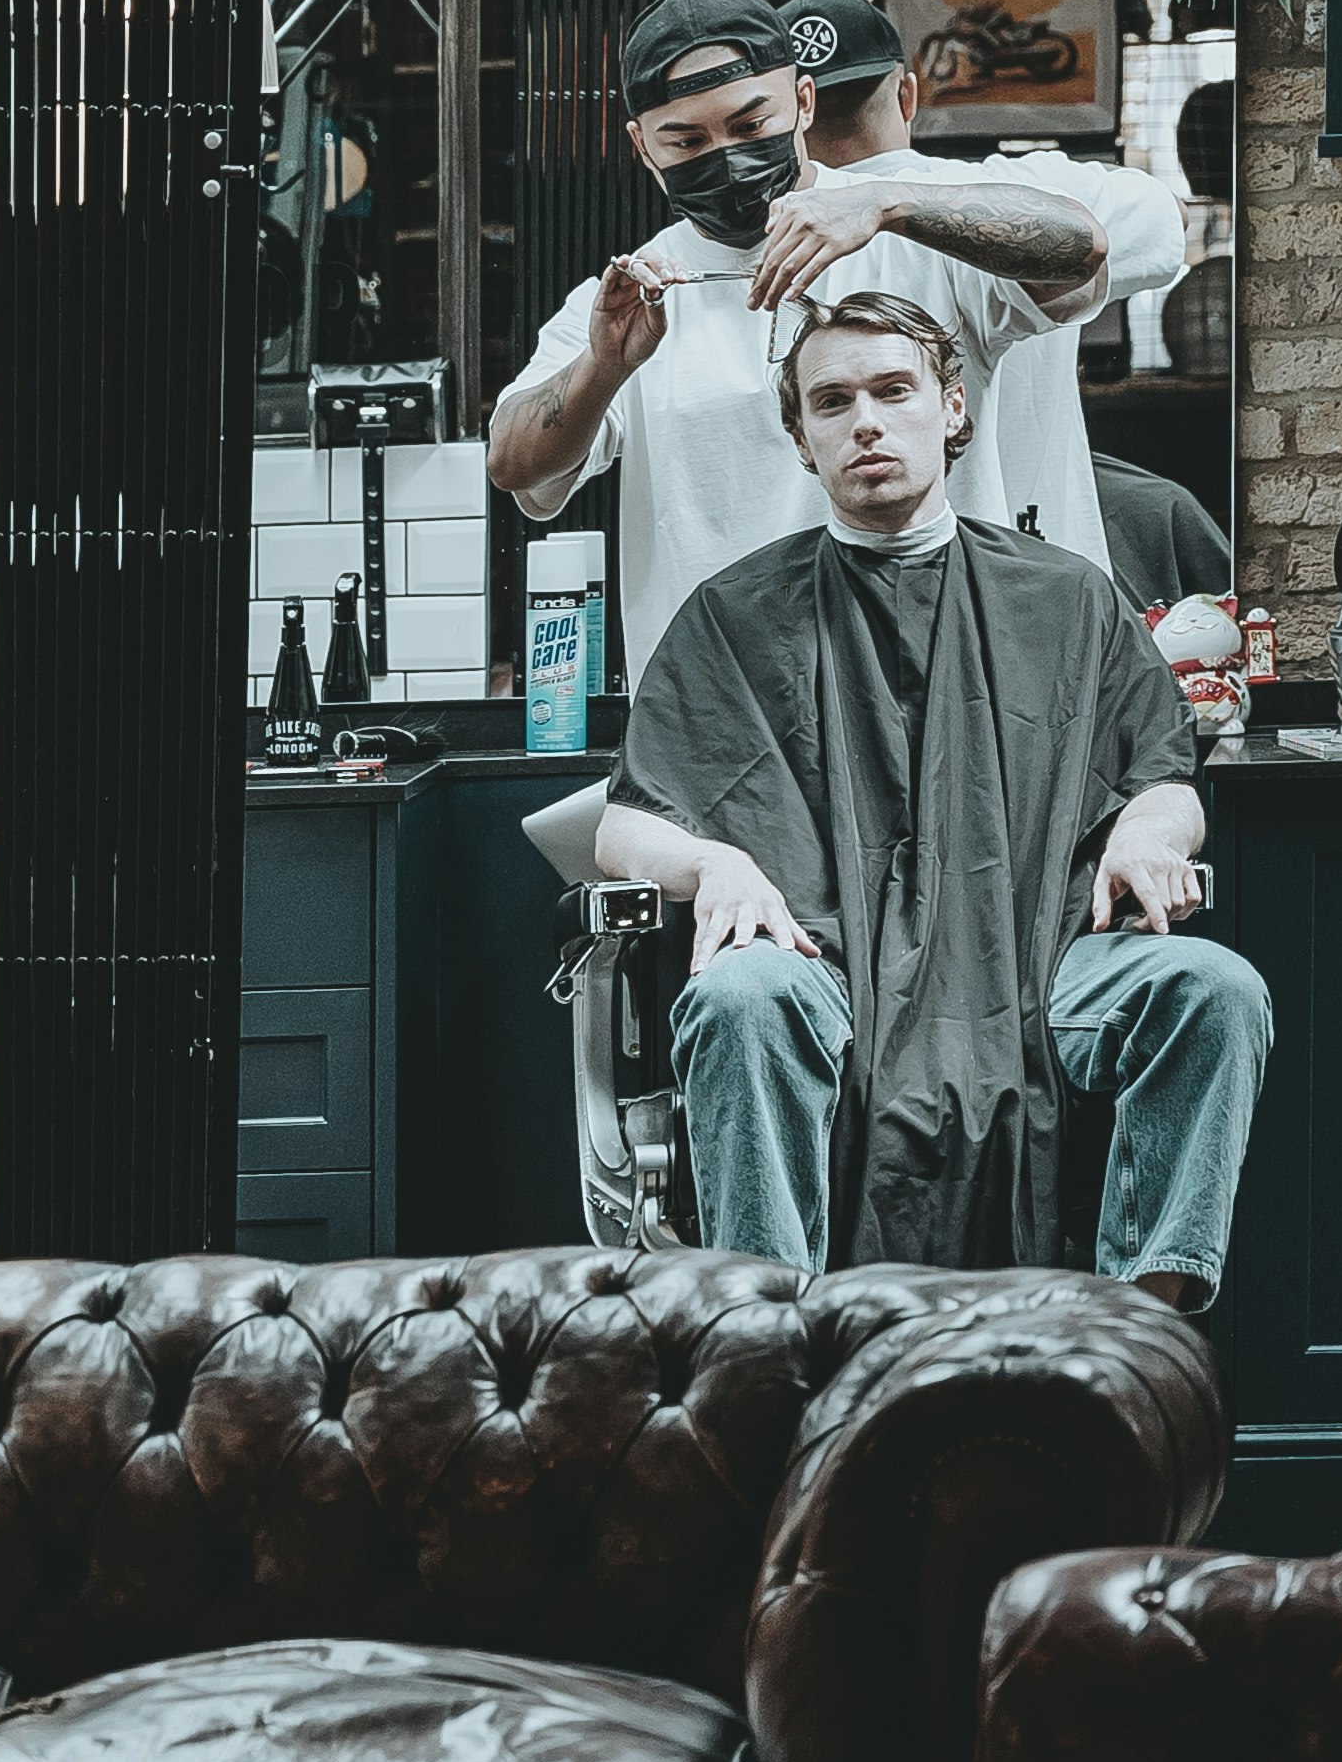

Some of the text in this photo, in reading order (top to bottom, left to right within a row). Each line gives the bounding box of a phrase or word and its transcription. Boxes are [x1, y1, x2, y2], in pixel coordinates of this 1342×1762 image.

[533, 596, 576, 609] andis
[531, 664, 575, 680] PLUS
[275, 720, 302, 734] BIKE
[269, 742, 313, 755] LONDON
